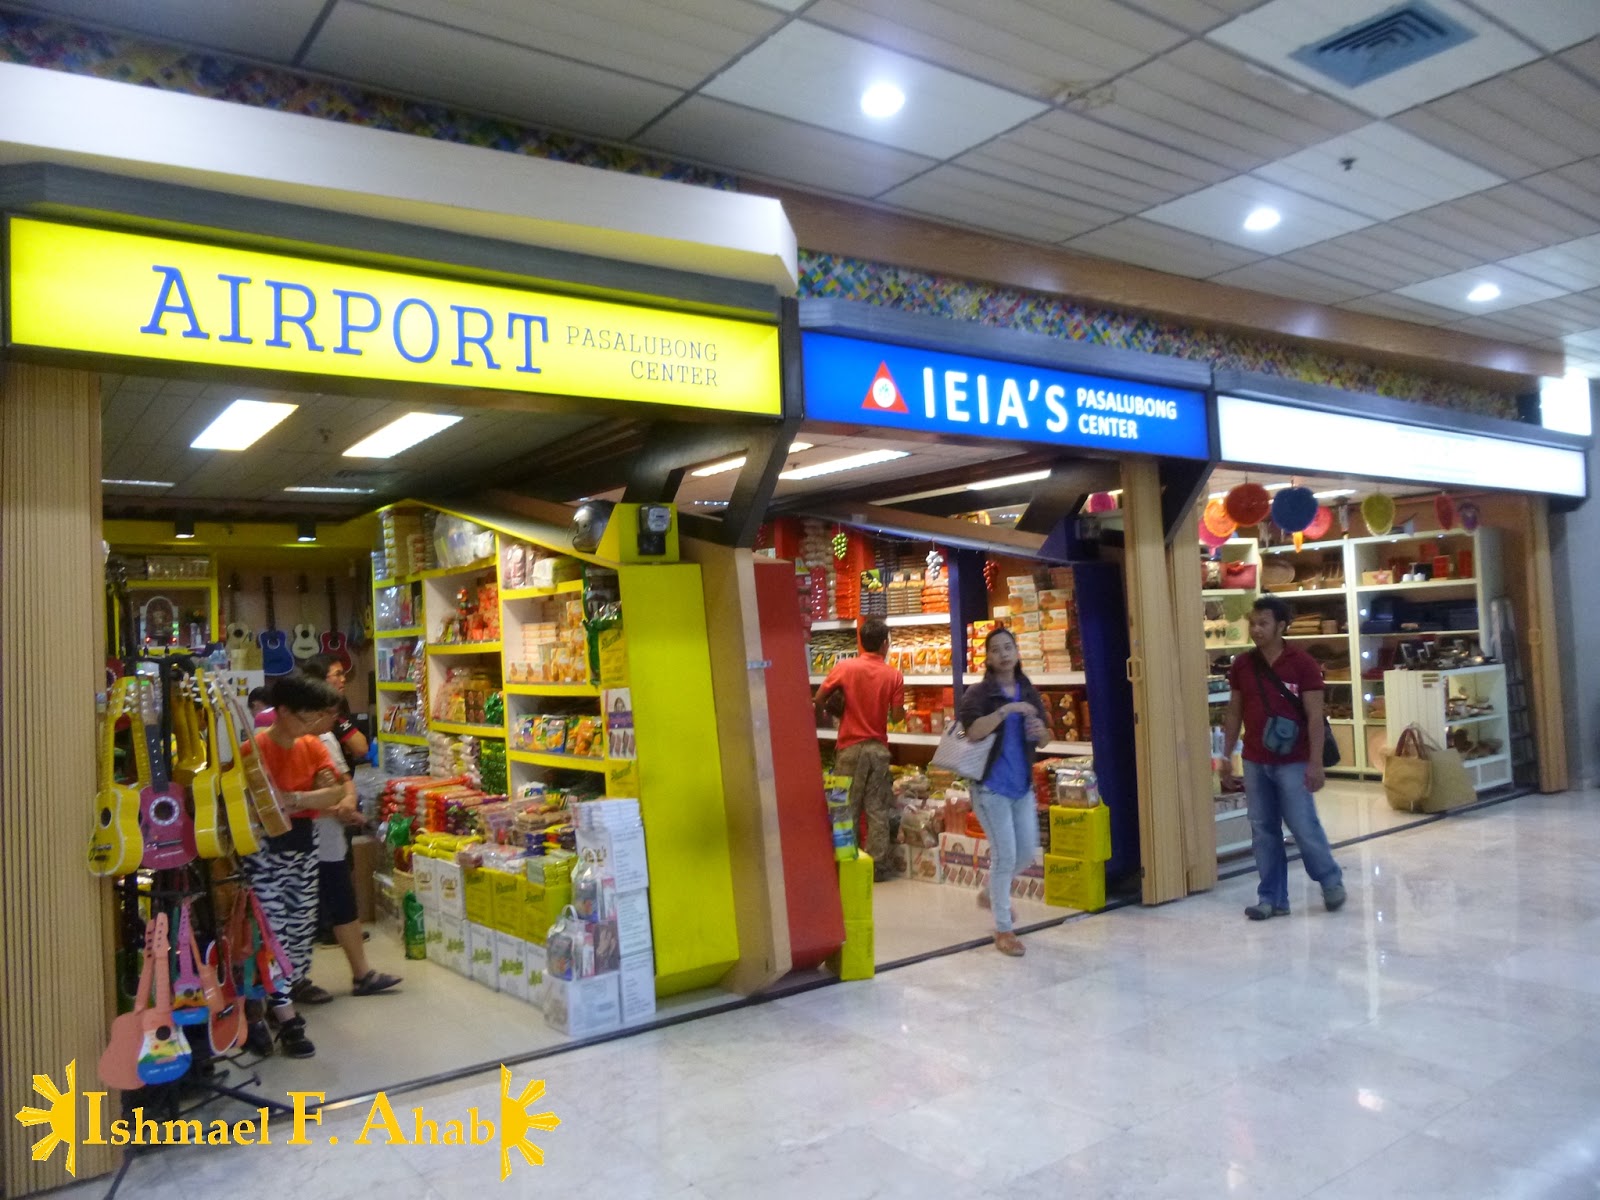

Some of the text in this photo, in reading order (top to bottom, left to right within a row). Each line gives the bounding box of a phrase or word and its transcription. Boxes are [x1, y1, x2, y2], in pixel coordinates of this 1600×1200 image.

[139, 264, 549, 374] AIRPORT
[566, 325, 718, 362] PASALUBONG
[630, 359, 718, 387] CENTER
[1076, 387, 1178, 420] PASALUBONG
[1077, 413, 1139, 440] CENTER
